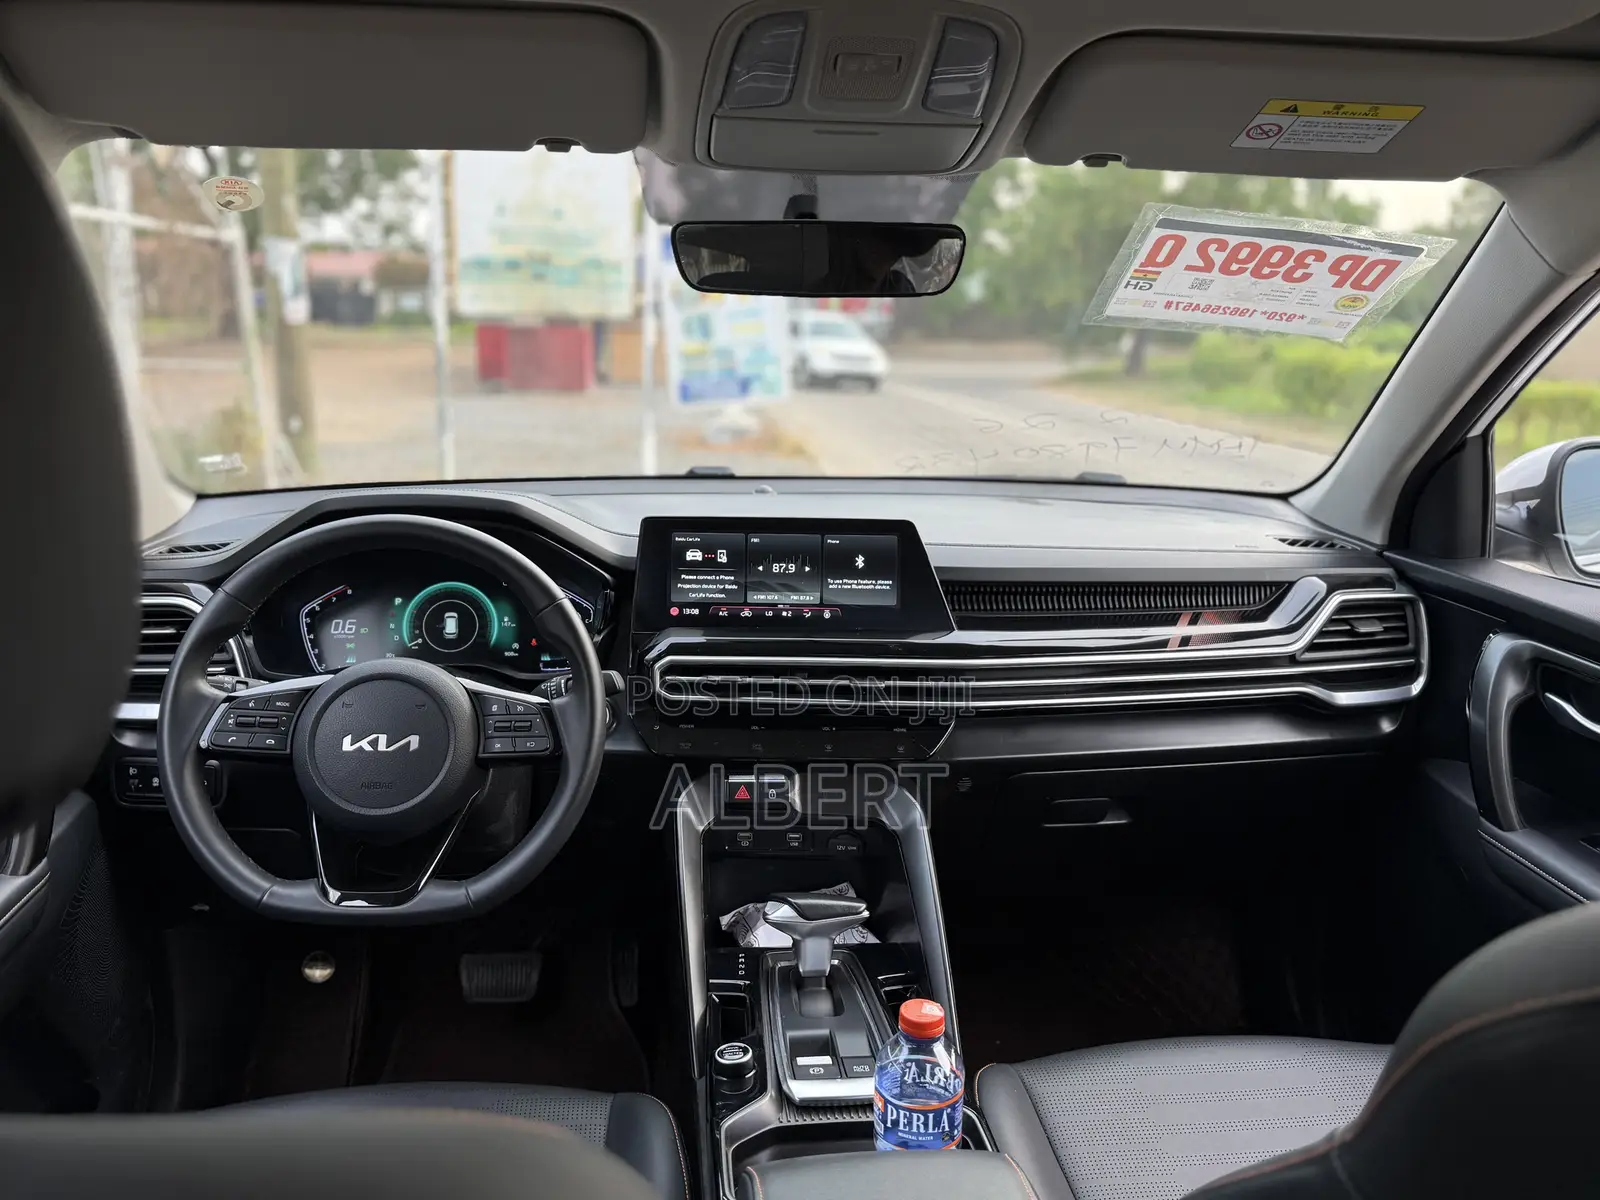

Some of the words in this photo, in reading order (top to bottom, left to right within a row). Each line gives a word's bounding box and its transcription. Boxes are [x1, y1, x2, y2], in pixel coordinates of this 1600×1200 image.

[772, 563, 796, 573] 87.9
[394, 597, 403, 606] P
[331, 619, 357, 634] 0.6
[360, 781, 394, 790] AIRBAG
[886, 1103, 950, 1133] PERLA
